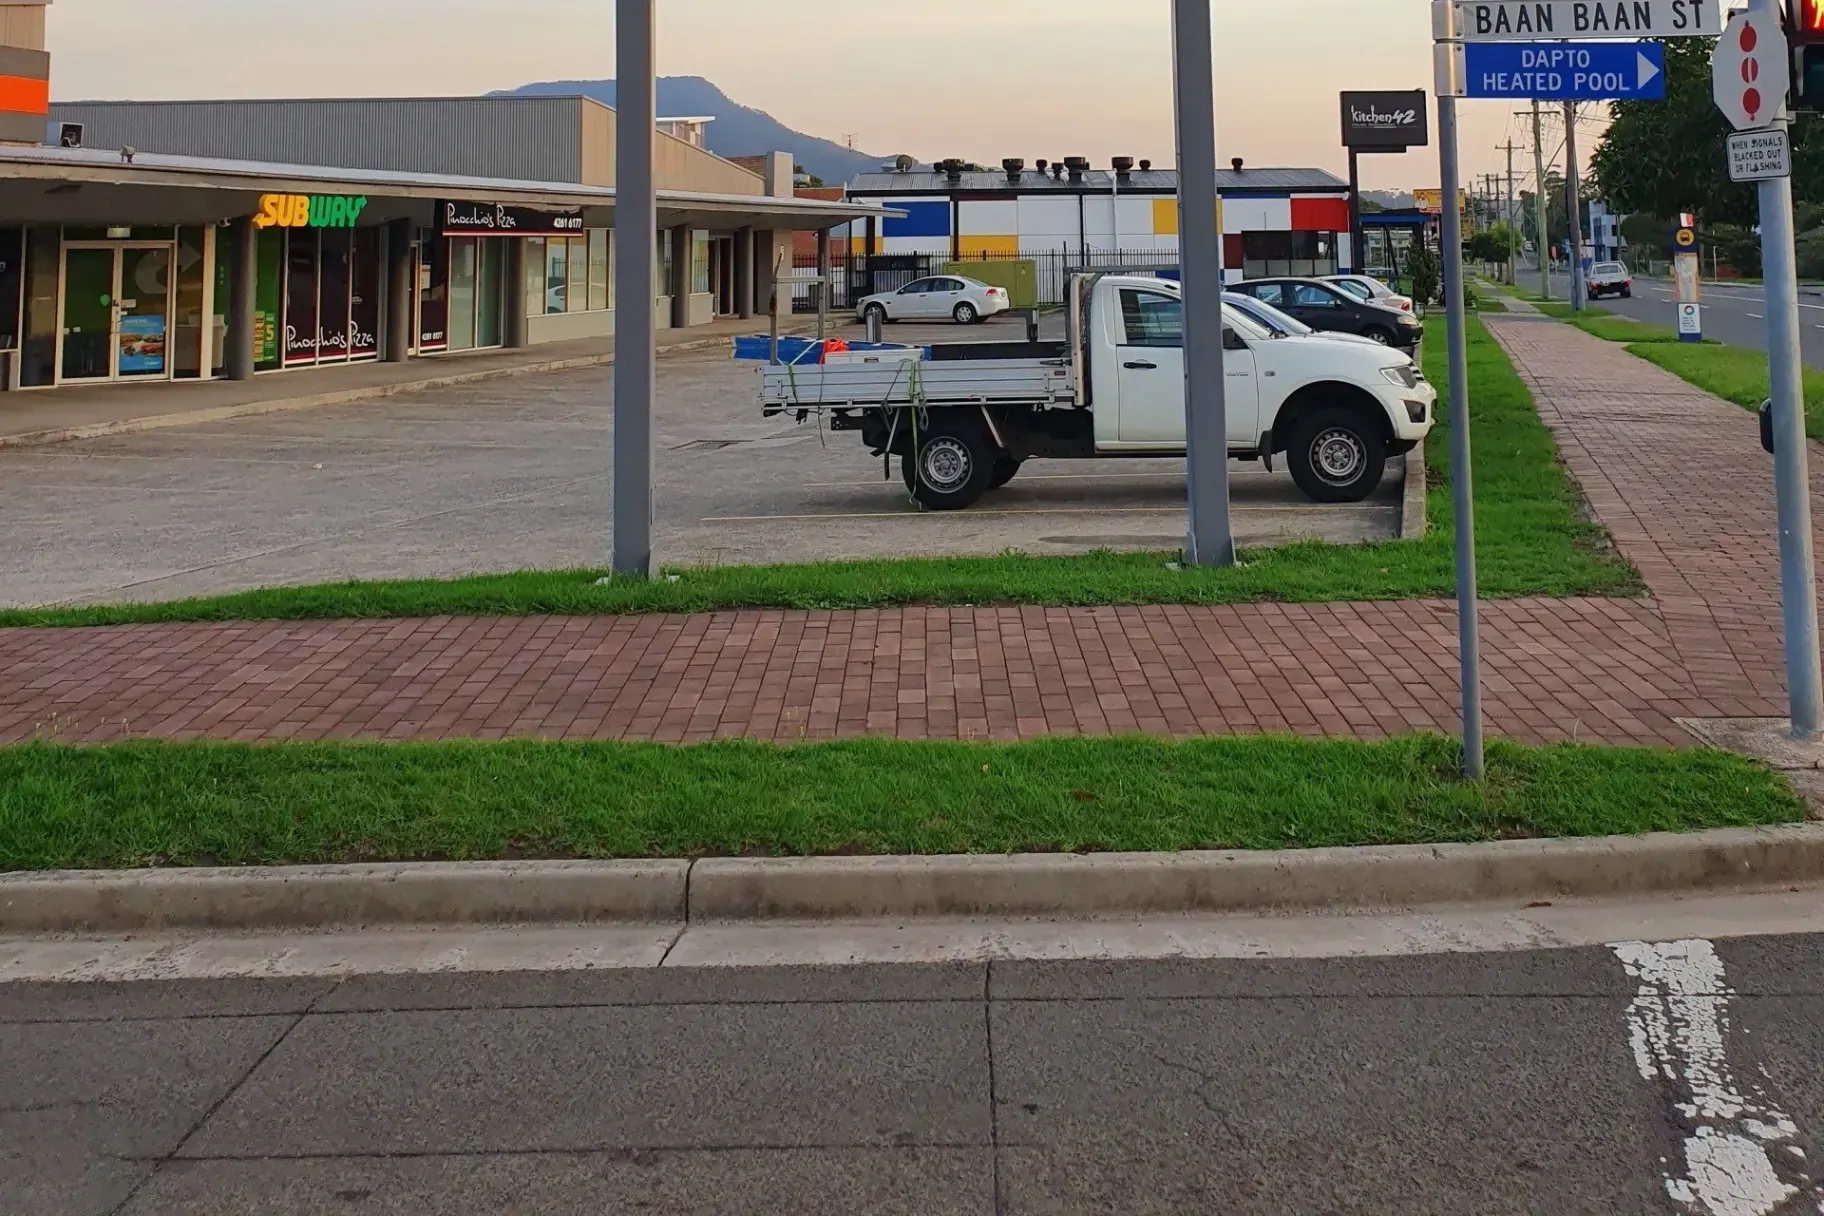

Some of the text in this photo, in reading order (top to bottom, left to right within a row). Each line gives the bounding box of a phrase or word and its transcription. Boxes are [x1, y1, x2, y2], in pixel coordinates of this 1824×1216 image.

[1476, 0, 1704, 34] BAAN BAAN ST
[1521, 50, 1591, 68] DAPTO
[1483, 72, 1631, 91] HEATED POOL
[1751, 137, 1782, 148] SIGNALS
[1734, 149, 1781, 162] BLACKED OUT
[1736, 161, 1782, 173] OR FLASHING
[252, 194, 368, 229] SUBWAY
[447, 203, 494, 228] Pinocchio's
